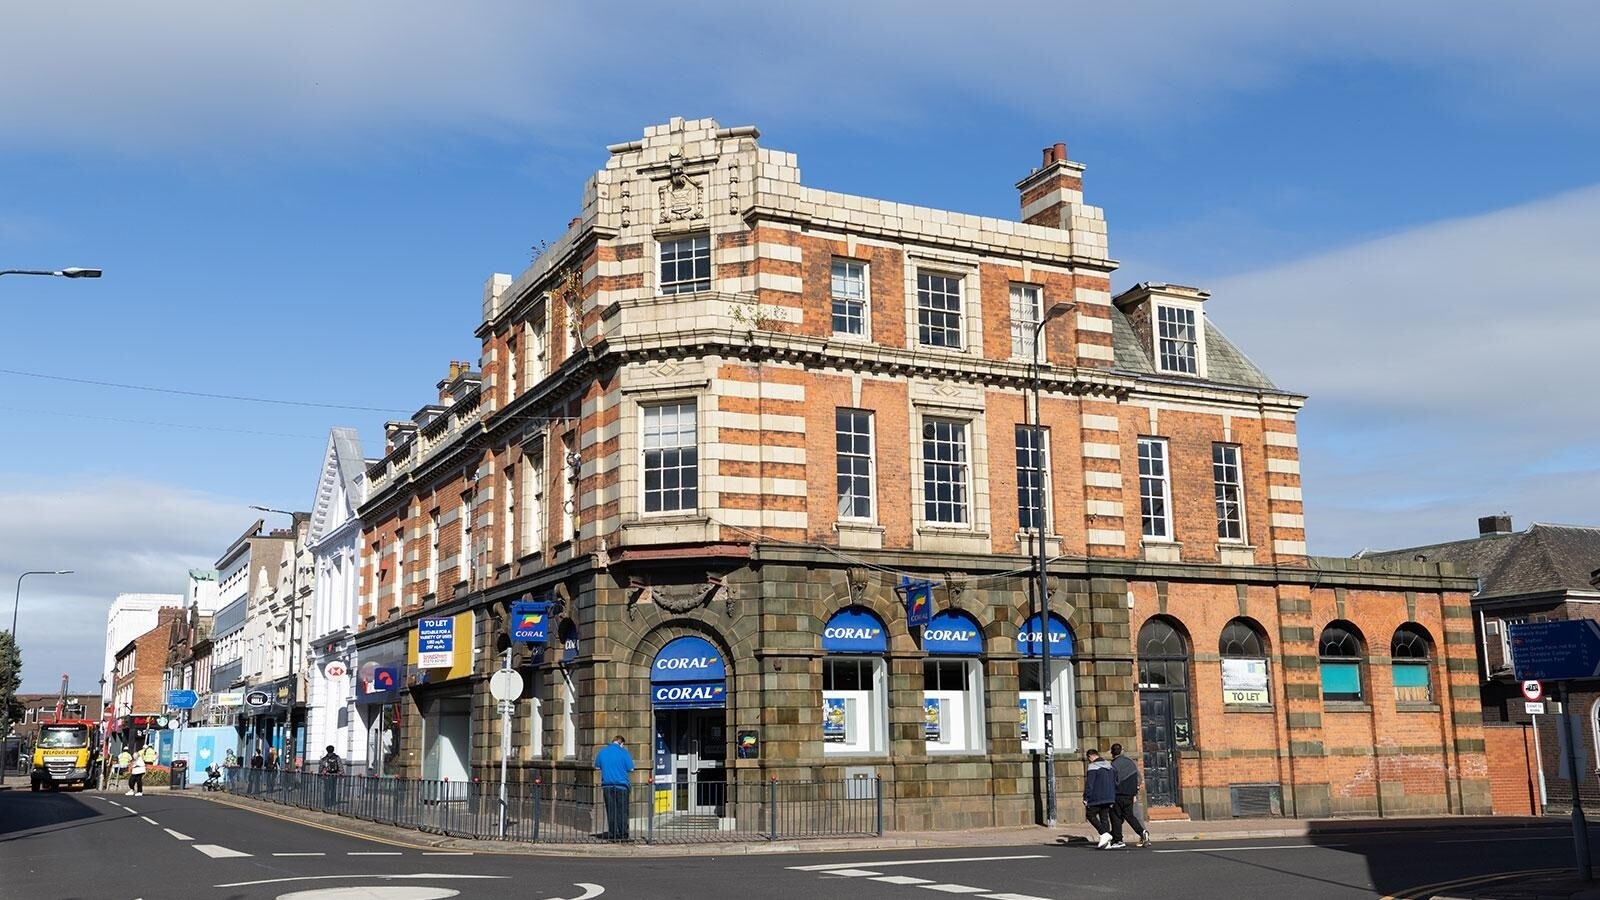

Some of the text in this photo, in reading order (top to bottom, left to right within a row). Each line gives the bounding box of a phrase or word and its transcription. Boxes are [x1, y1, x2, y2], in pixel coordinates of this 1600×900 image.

[911, 614, 928, 622] CORAL
[824, 628, 872, 639] CORAL
[923, 630, 969, 641] CORAL
[656, 658, 708, 669] CORAL
[656, 687, 713, 700] CORAL
[1232, 692, 1244, 700] TO
